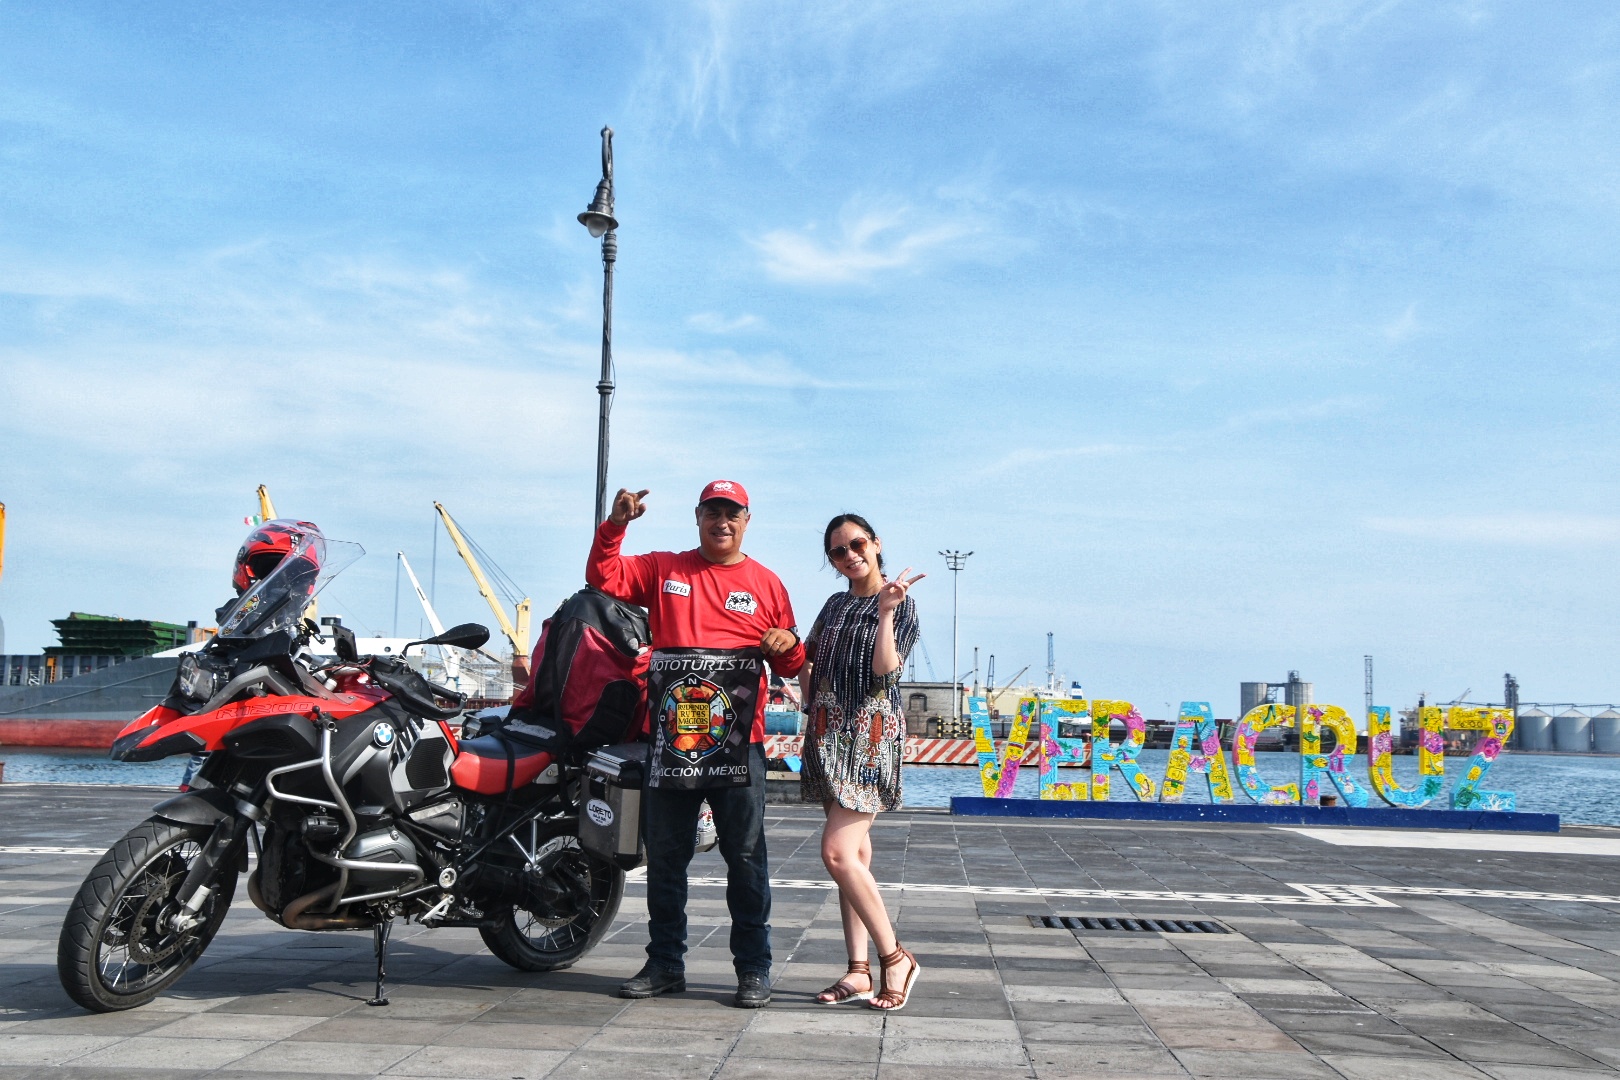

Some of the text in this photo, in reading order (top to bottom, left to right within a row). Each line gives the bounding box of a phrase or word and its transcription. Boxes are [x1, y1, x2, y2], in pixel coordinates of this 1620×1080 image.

[665, 580, 687, 594] Paris
[650, 658, 757, 672] MOTOTURISTA
[216, 702, 314, 719] R1200
[776, 743, 798, 753] 190
[968, 697, 1516, 812] VERACRUZ
[708, 763, 748, 776] MÉXICO
[588, 803, 612, 819] LORETO
